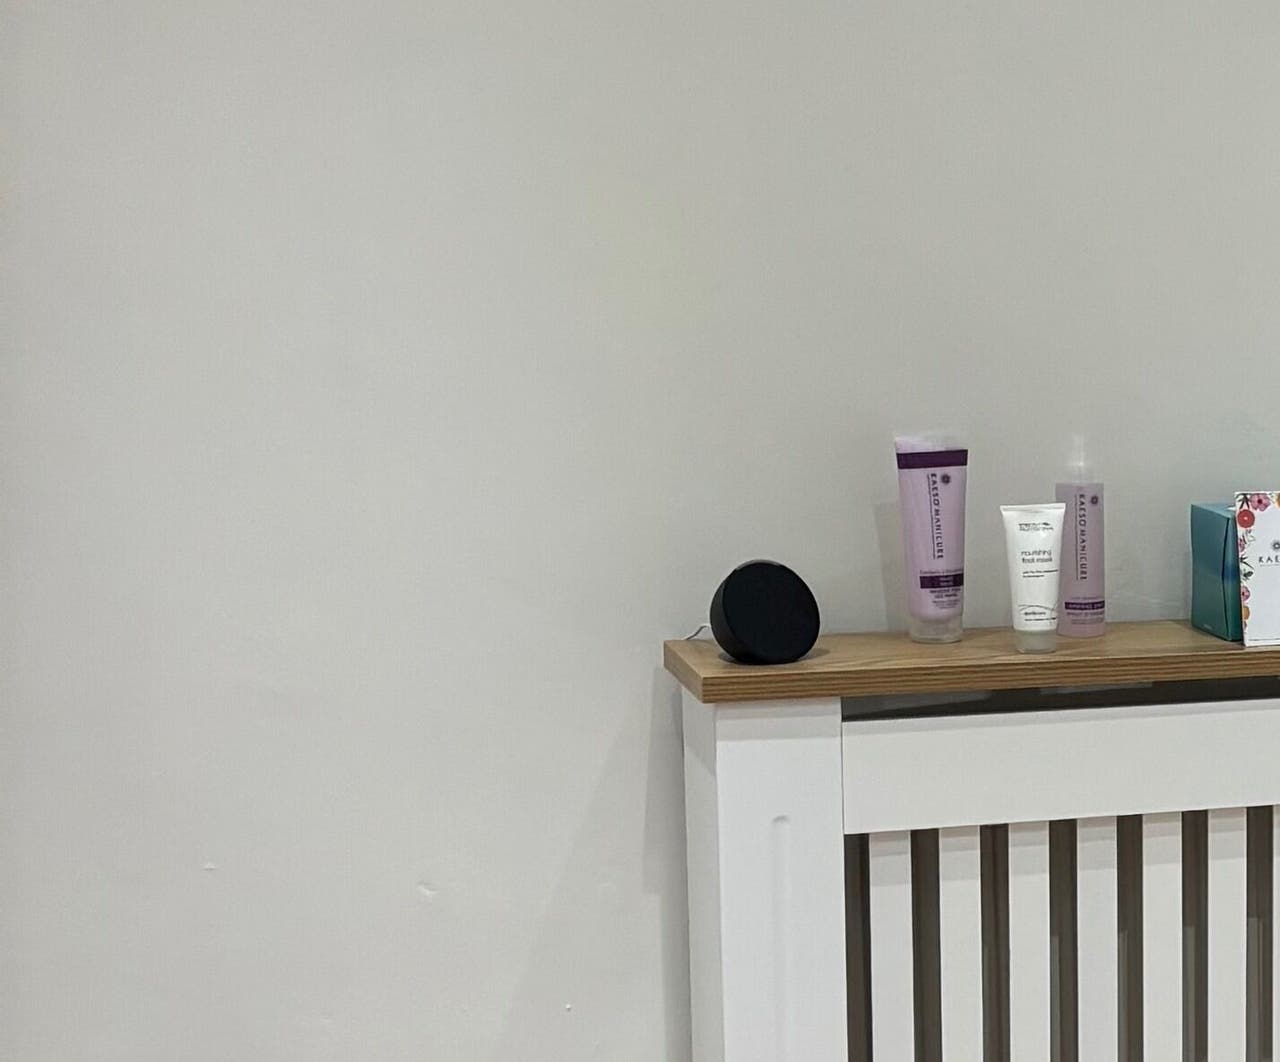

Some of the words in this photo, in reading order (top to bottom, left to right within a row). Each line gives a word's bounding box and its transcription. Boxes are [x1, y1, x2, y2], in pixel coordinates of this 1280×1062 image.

[930, 473, 940, 506] KAESO
[1078, 494, 1087, 528] KAESO
[1079, 529, 1088, 580] MANICURE
